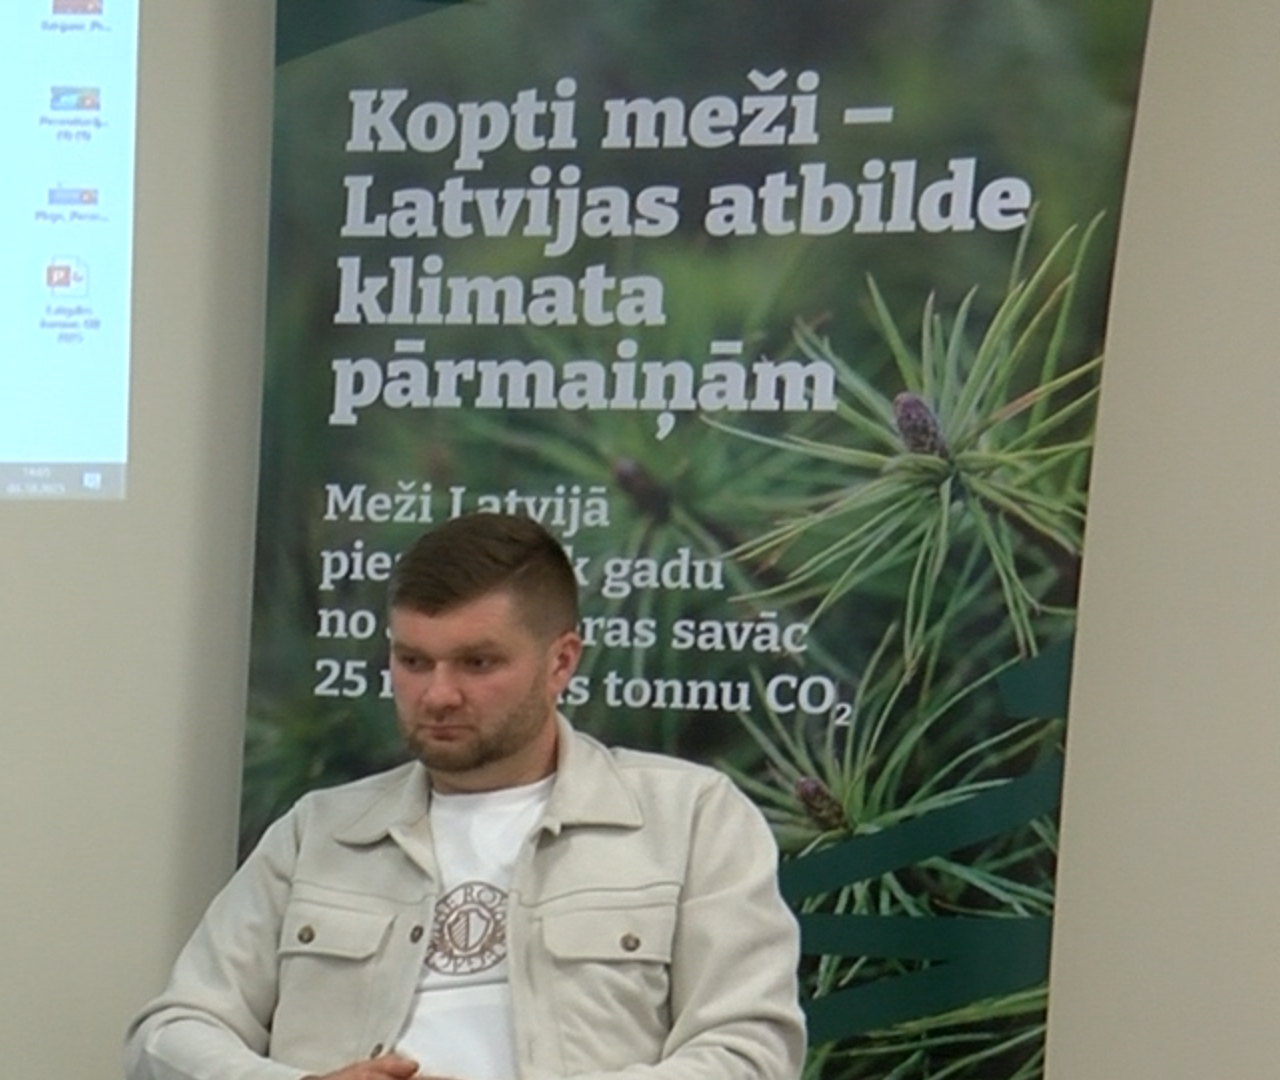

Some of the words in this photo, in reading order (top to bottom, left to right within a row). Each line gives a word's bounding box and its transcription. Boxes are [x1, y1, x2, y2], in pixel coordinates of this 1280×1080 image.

[345, 77, 579, 170] Kopti
[601, 68, 820, 149] meži
[340, 162, 679, 255] Latvijas
[704, 157, 1032, 236] atbilde
[334, 252, 667, 327] klimata
[329, 338, 841, 439] pārmaiņām
[323, 480, 433, 523] Meži
[602, 548, 724, 602] gadu
[316, 606, 377, 640] no
[672, 611, 809, 653] savāc
[313, 658, 368, 698] 25
[603, 671, 751, 713] tonnu
